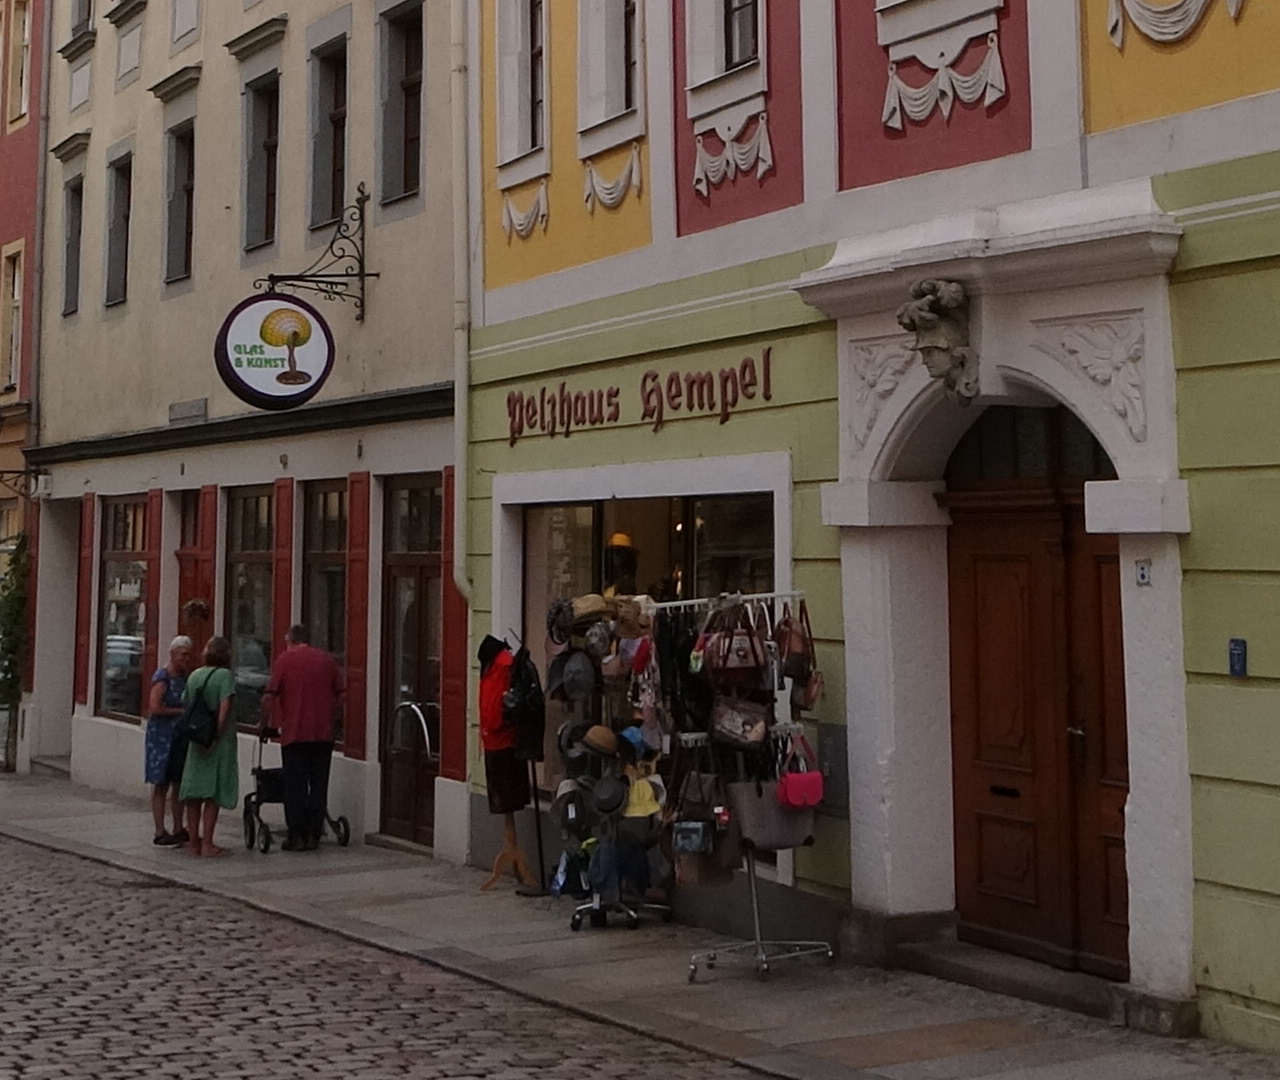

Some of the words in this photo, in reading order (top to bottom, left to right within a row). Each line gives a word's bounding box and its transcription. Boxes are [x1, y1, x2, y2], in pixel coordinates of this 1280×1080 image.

[233, 344, 265, 356] GLAS
[234, 357, 243, 368] &
[246, 357, 287, 368] KUNST
[507, 381, 620, 448] Pelzhaus
[639, 346, 773, 434] Hempel
